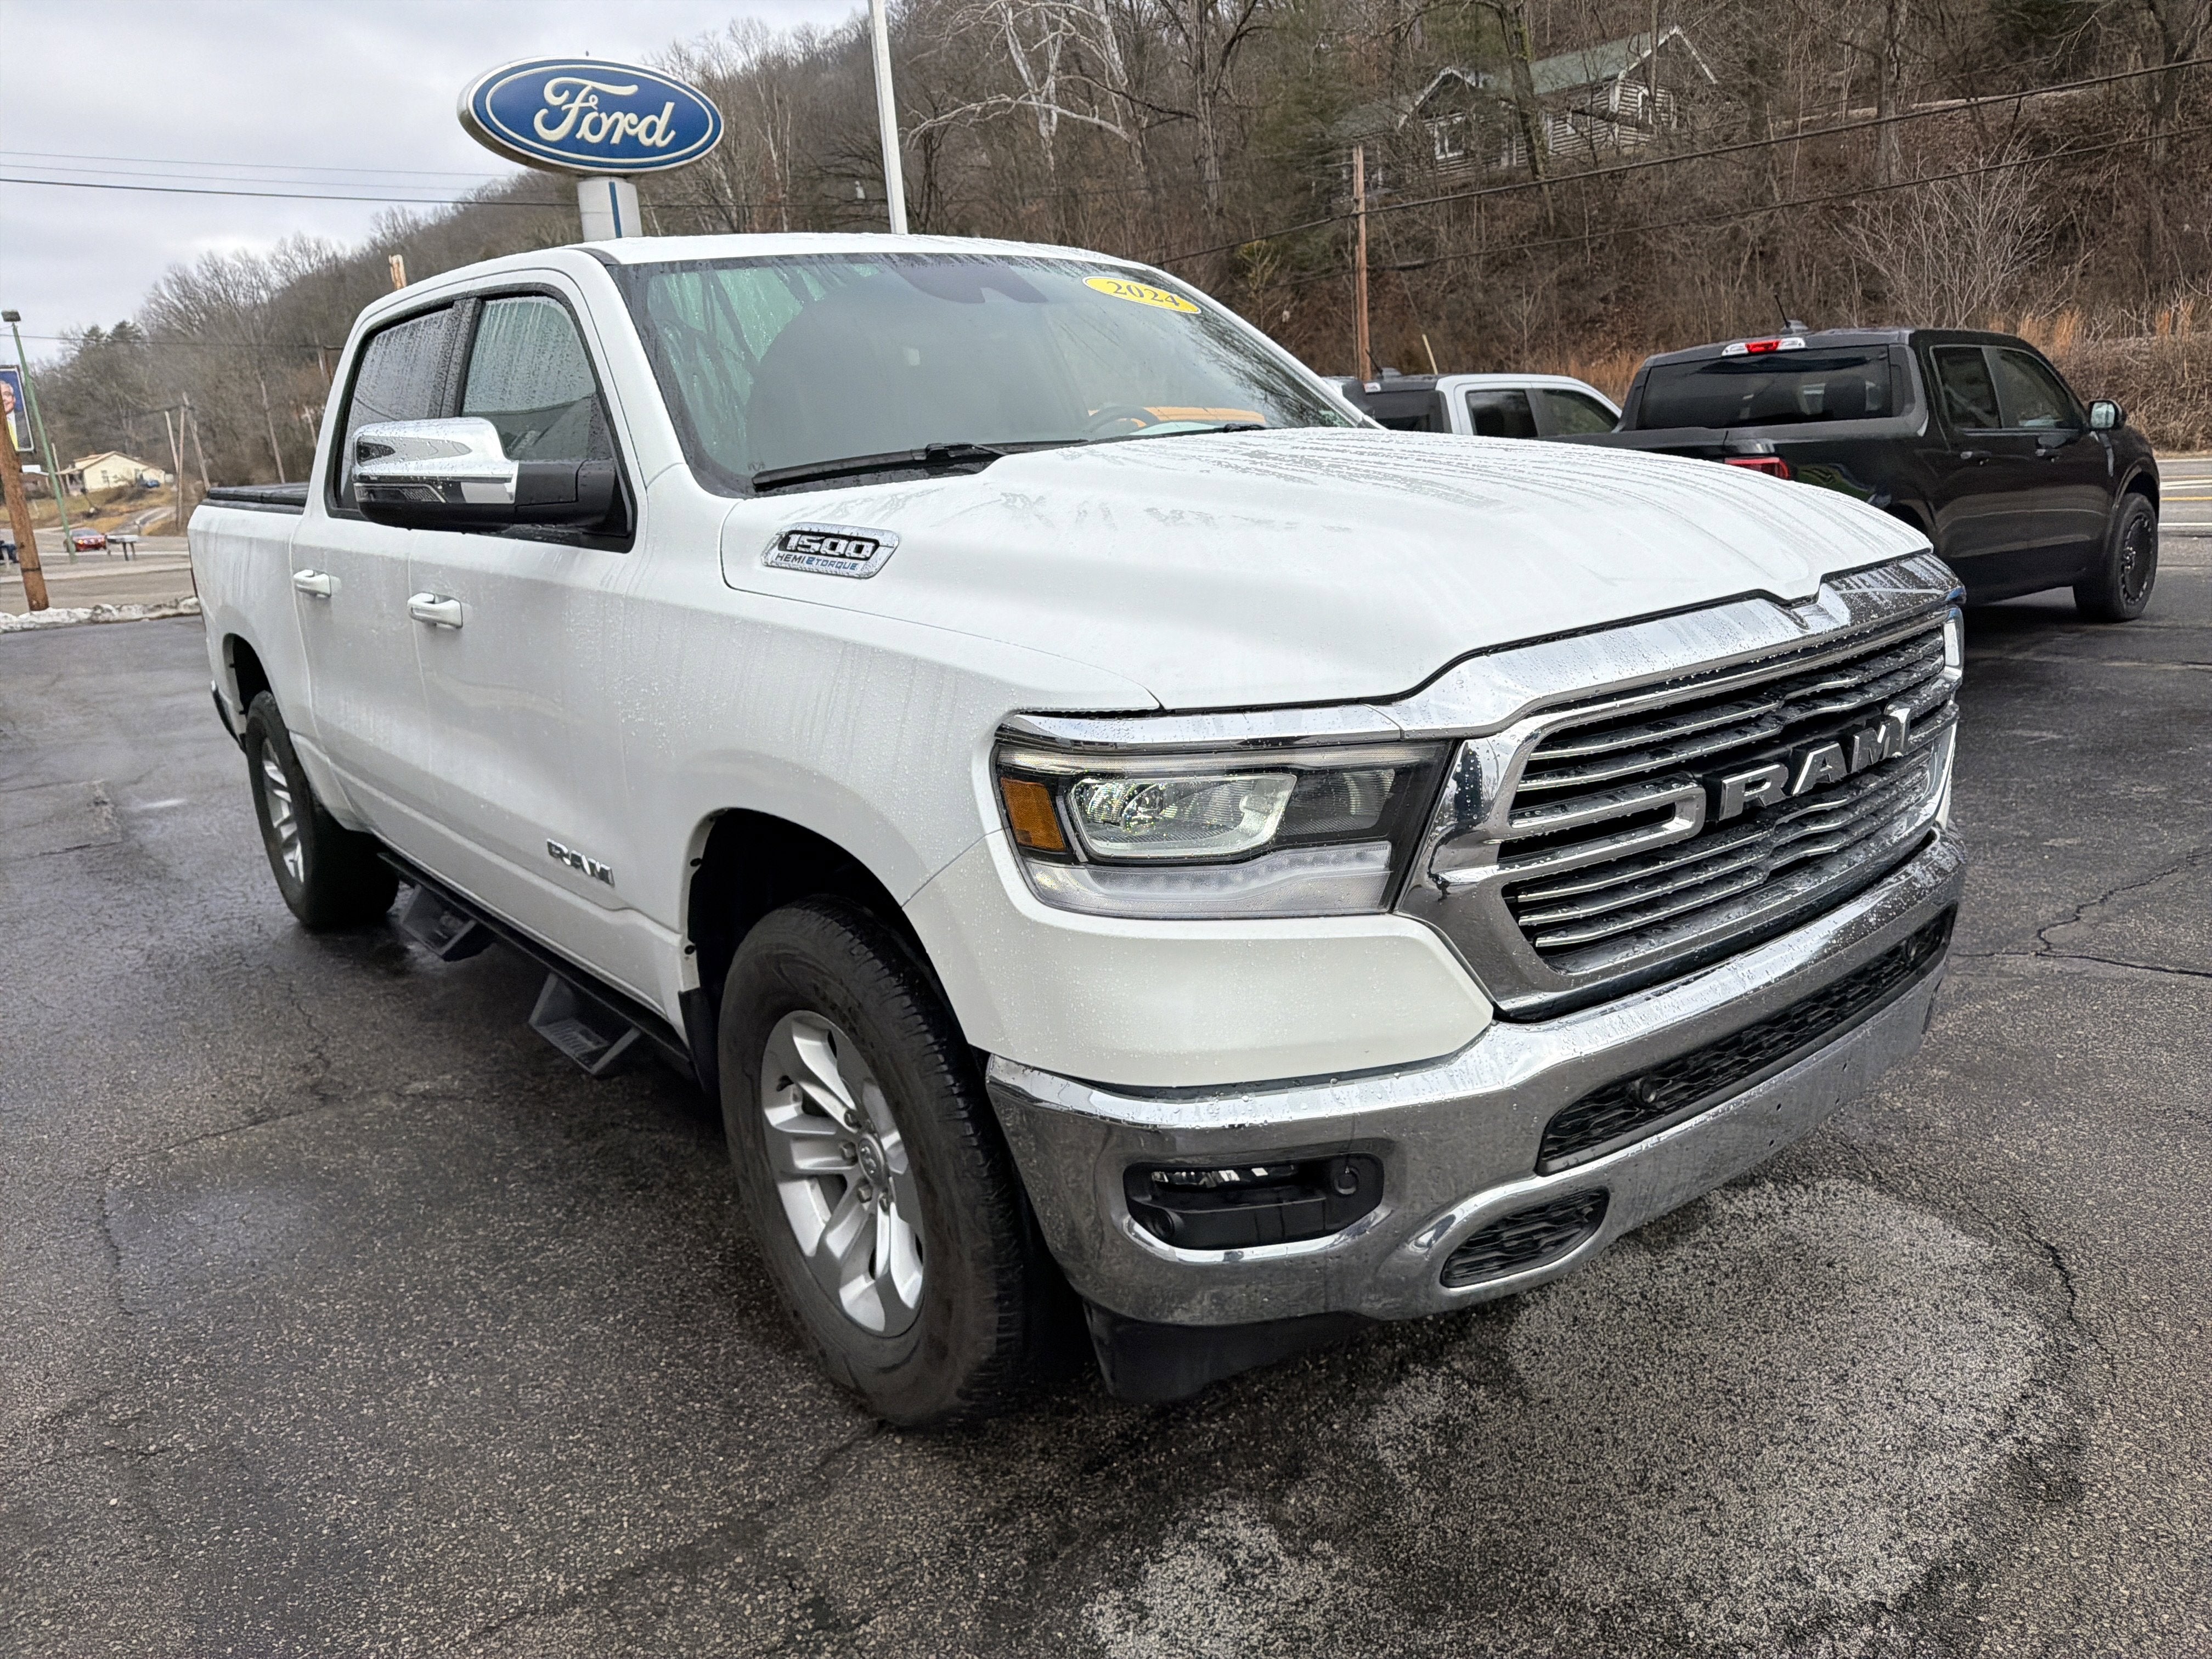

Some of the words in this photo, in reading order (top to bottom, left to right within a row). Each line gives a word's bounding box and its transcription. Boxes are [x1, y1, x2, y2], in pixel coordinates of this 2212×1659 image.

[533, 77, 675, 147] Ford
[1107, 281, 1180, 307] 2024
[775, 552, 806, 565] HEMI
[786, 534, 875, 558] 1500
[1719, 708, 1910, 821] RAM
[547, 838, 615, 888] RAM
